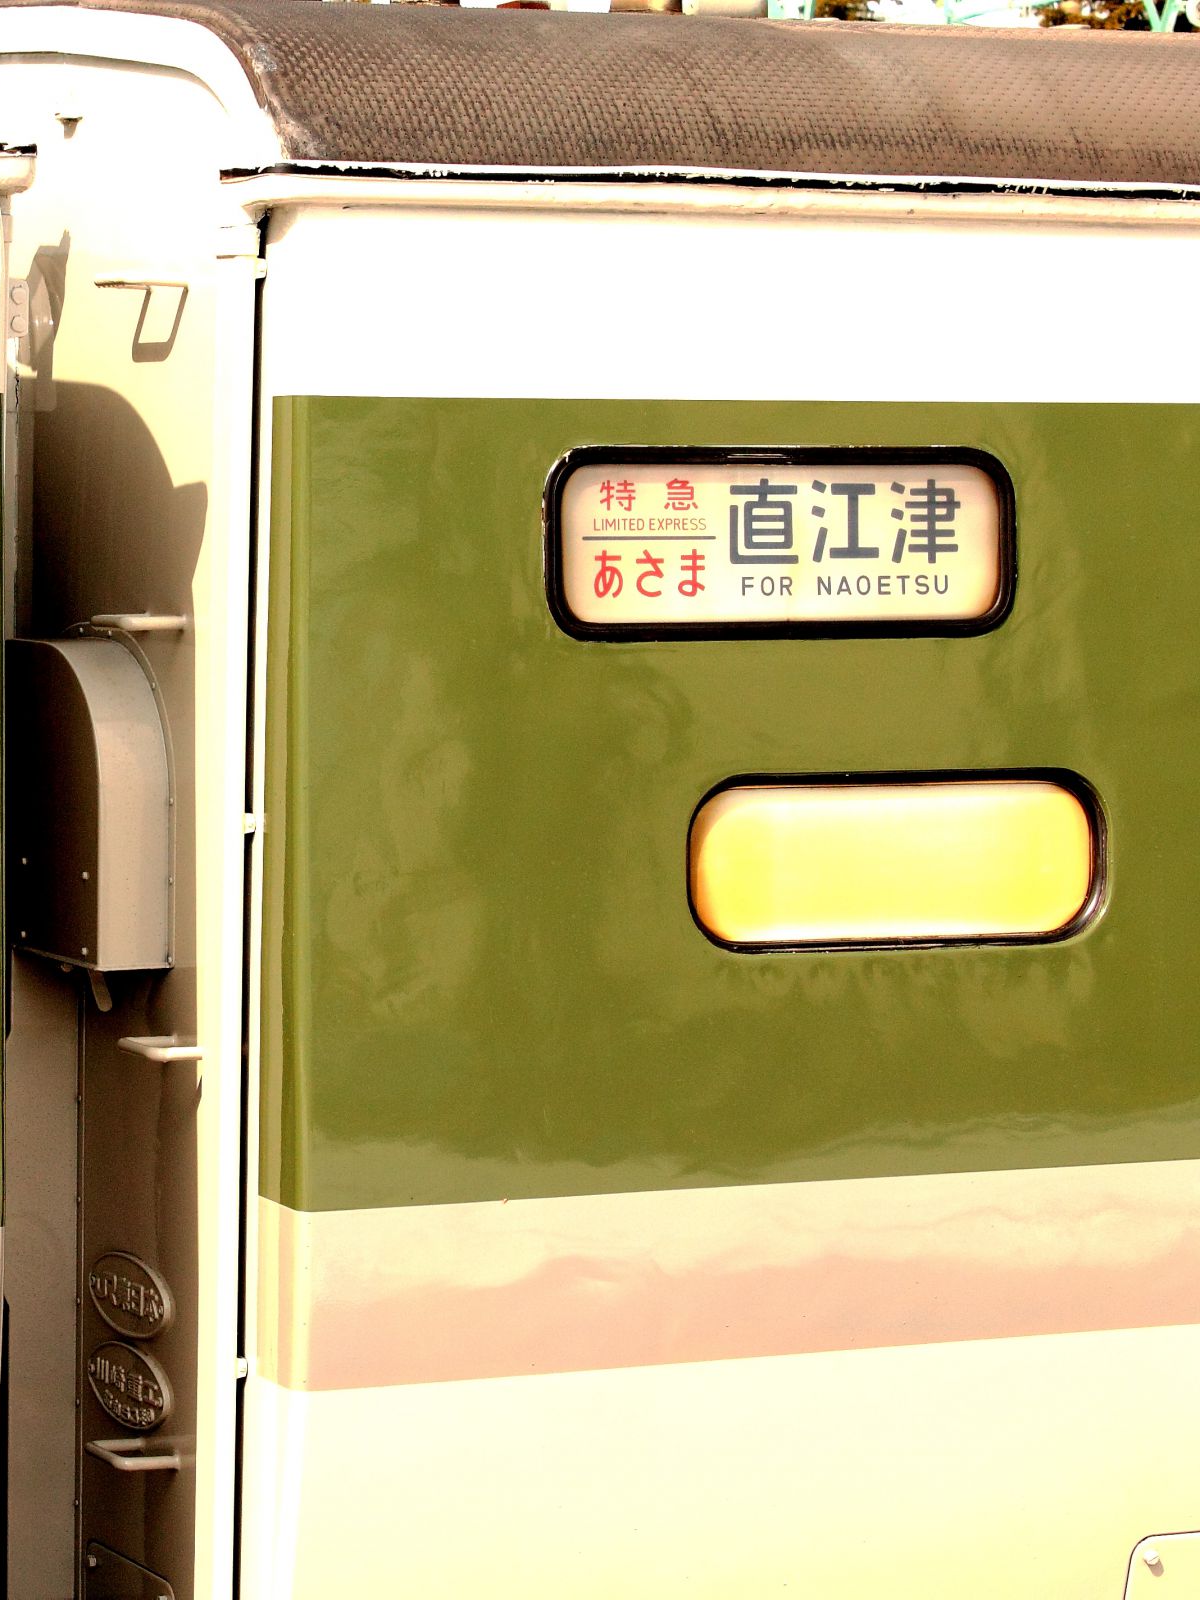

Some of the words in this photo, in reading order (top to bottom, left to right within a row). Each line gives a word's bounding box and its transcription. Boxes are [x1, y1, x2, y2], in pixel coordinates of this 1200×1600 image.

[599, 478, 699, 512] 特急
[593, 517, 645, 532] LIMITED
[648, 517, 707, 531] EXPRESS
[729, 478, 962, 565] 直江津
[593, 548, 706, 599] あさま
[741, 575, 793, 597] FOR
[816, 574, 949, 596] NAOETSU
